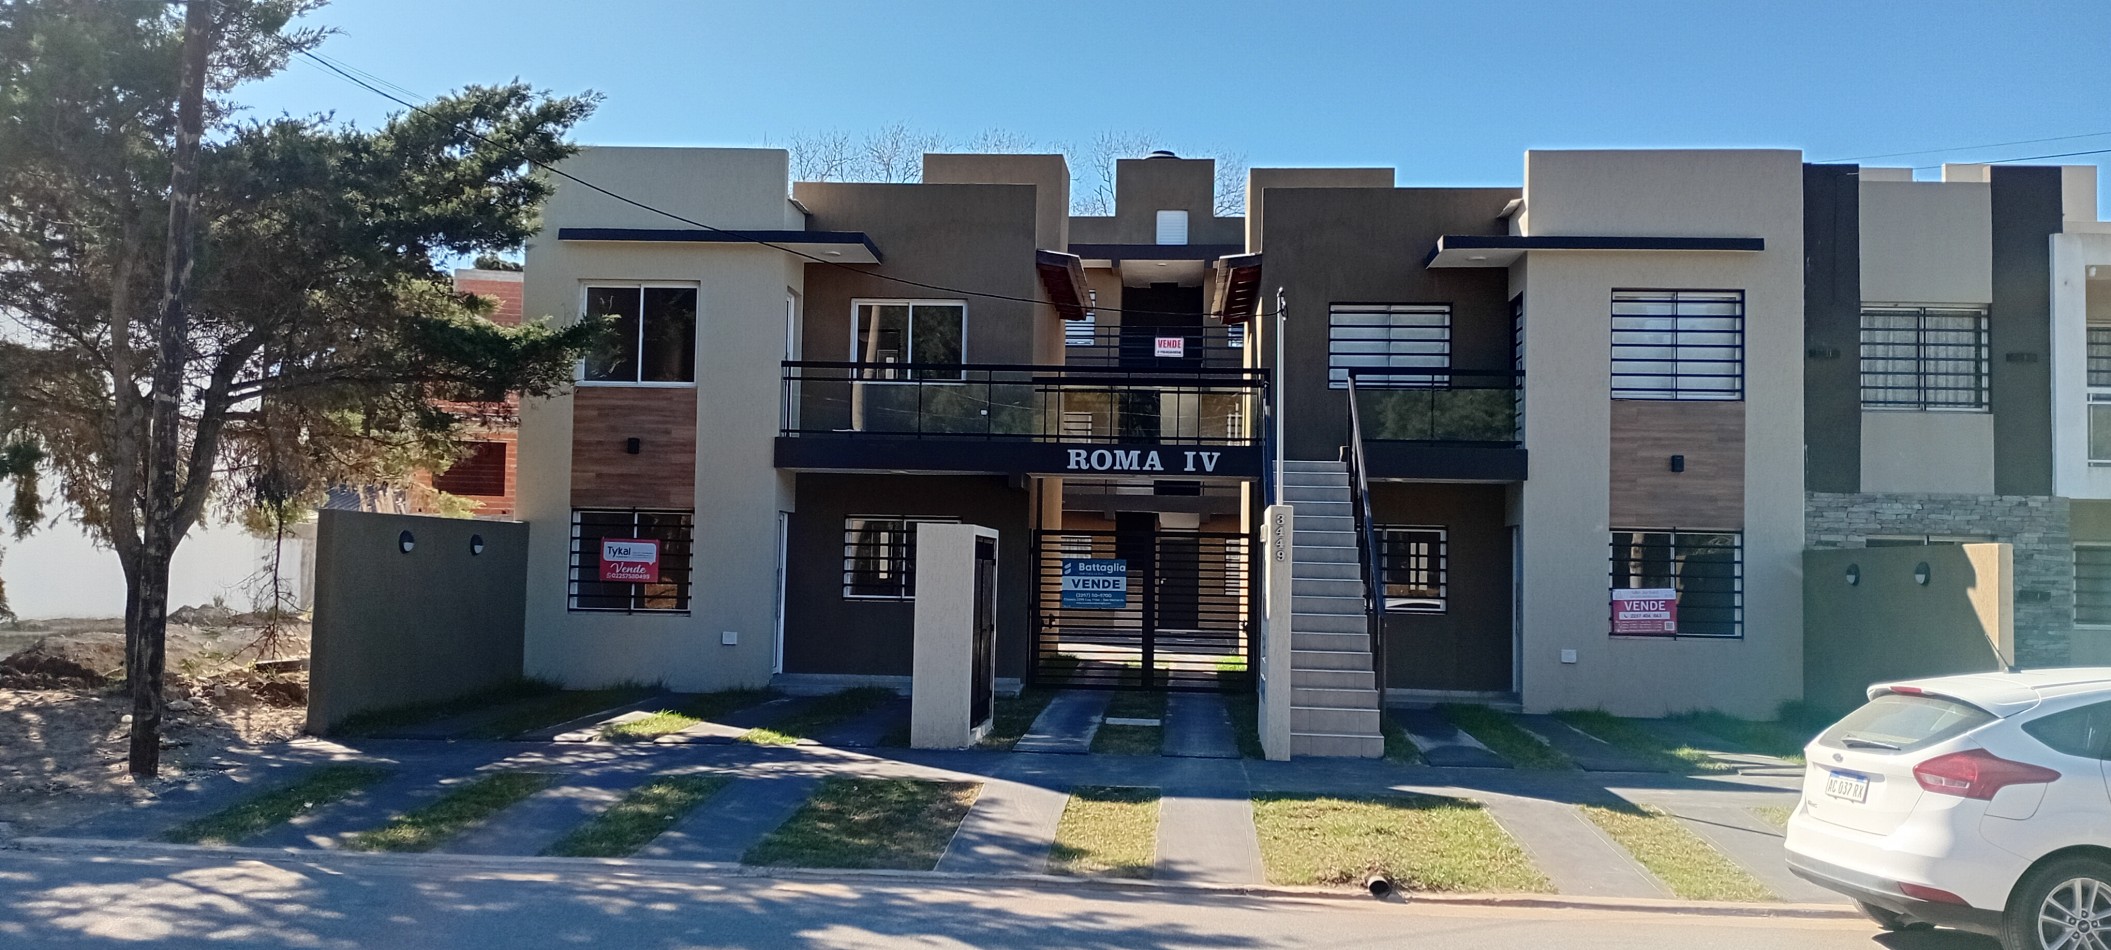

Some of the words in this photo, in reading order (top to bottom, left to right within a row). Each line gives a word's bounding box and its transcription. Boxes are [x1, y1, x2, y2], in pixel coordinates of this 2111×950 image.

[1158, 339, 1182, 348] VENDE
[1066, 449, 1165, 471] ROMA
[1183, 451, 1221, 472] IV
[1275, 513, 1286, 562] 3449
[607, 546, 631, 558] Tykal
[610, 561, 647, 574] Vende
[1078, 562, 1126, 574] Battaglia
[1071, 578, 1121, 589] VENDE
[1623, 600, 1666, 611] VENDE
[1827, 779, 1838, 793] AC
[1838, 781, 1853, 796] 037
[1852, 783, 1864, 799] RX
